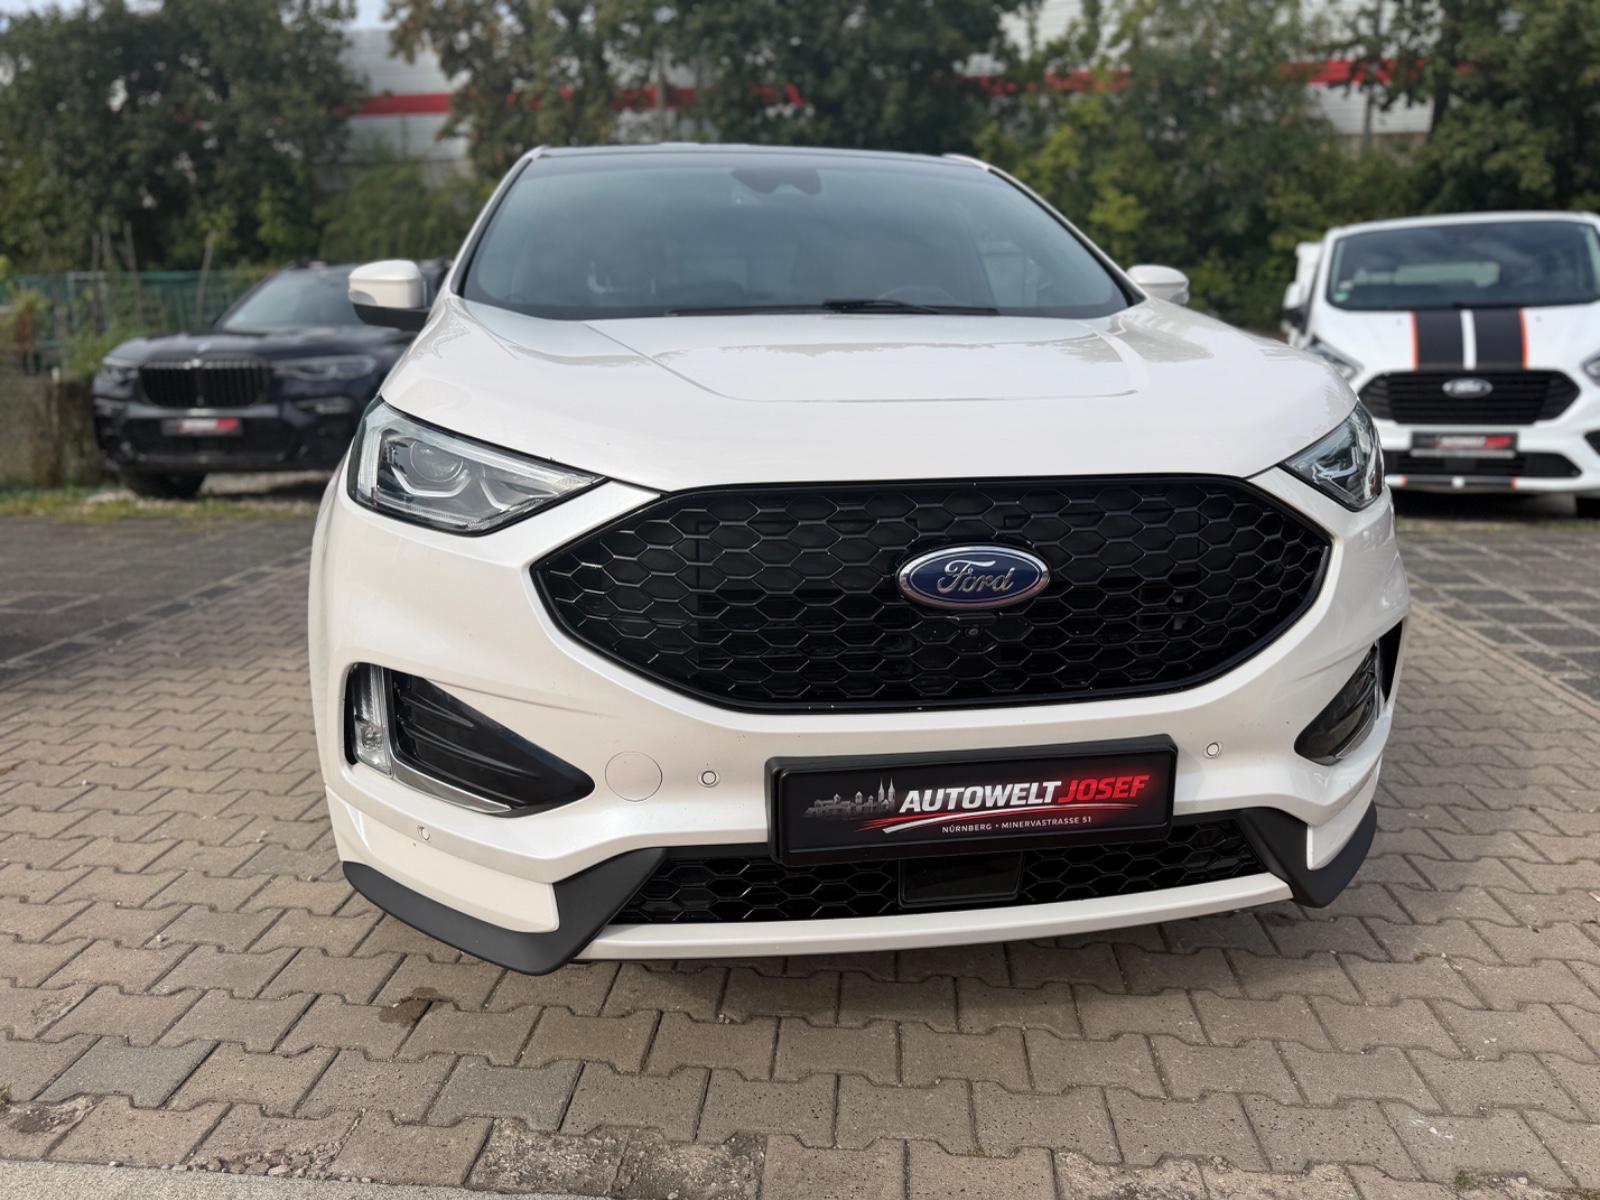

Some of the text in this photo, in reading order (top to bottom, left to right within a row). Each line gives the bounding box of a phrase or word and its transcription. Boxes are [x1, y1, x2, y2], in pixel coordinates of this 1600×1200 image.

[936, 559, 1016, 593] Ford
[899, 774, 1150, 813] AUTOWELT JOSEF
[941, 815, 1092, 834] NÜRNBERG MINERVASTRASSE 51
